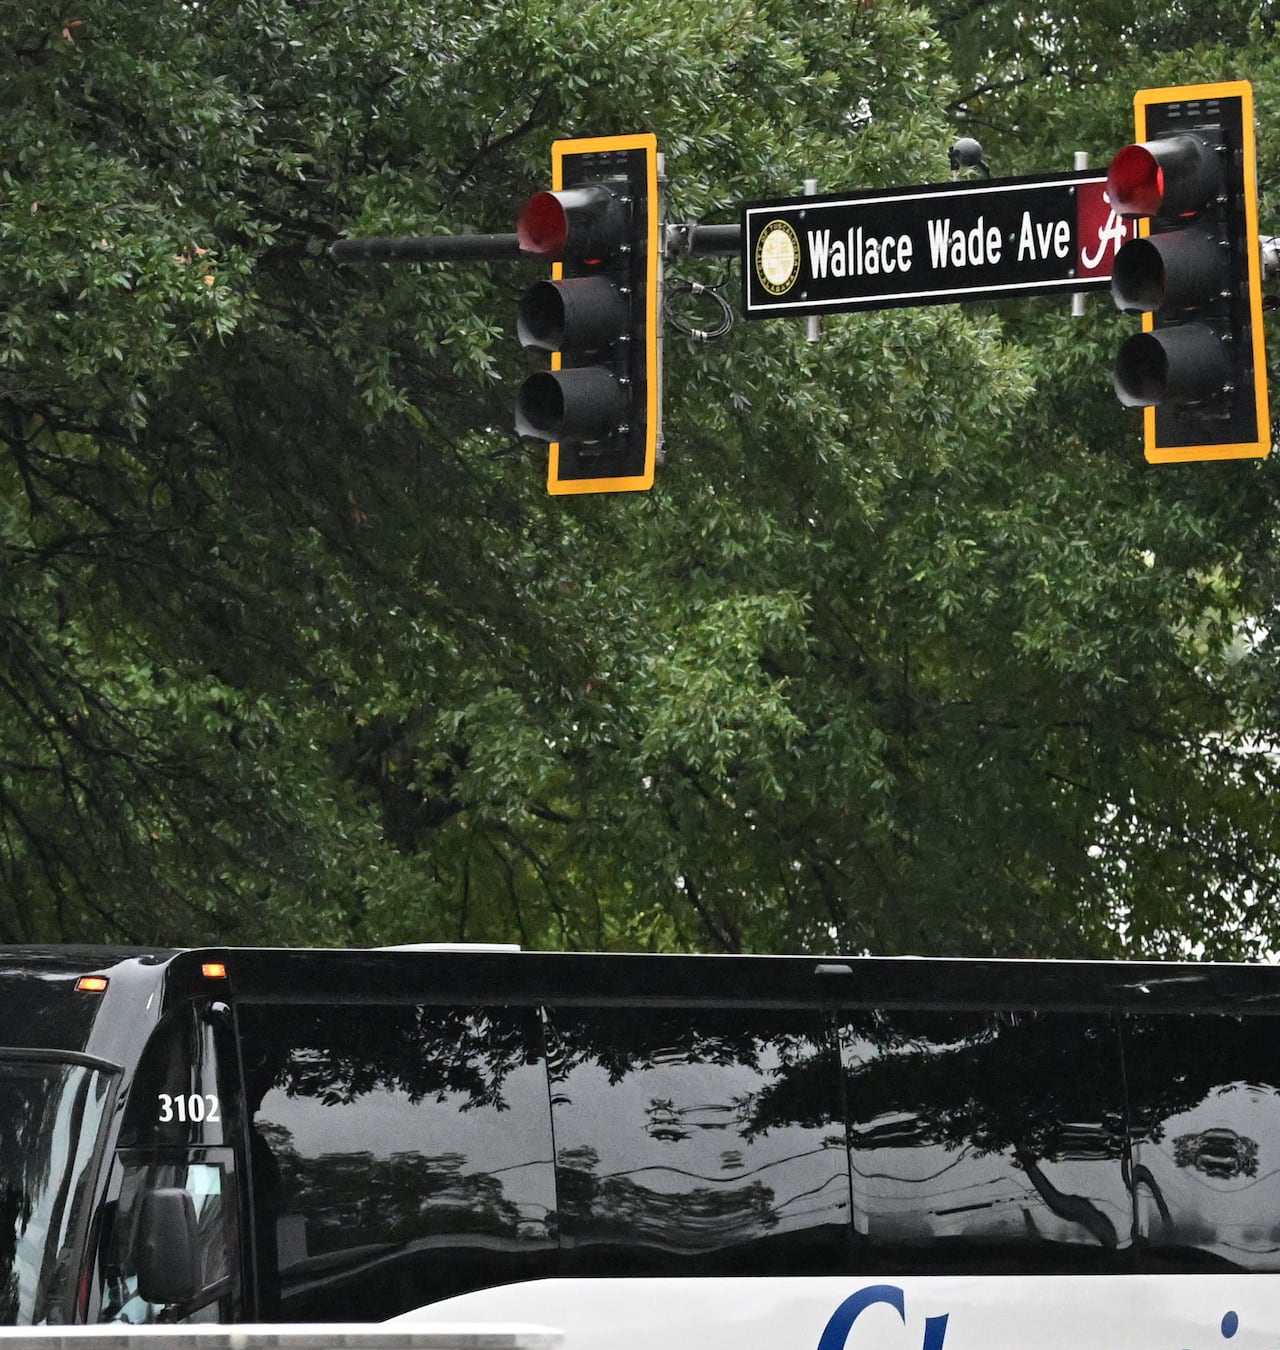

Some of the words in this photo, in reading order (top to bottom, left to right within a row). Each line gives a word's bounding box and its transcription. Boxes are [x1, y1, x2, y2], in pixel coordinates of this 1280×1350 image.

[808, 227, 913, 278] Wallace
[928, 217, 1001, 267] Wade
[1018, 211, 1070, 261] Ave
[158, 1093, 220, 1123] 3102
